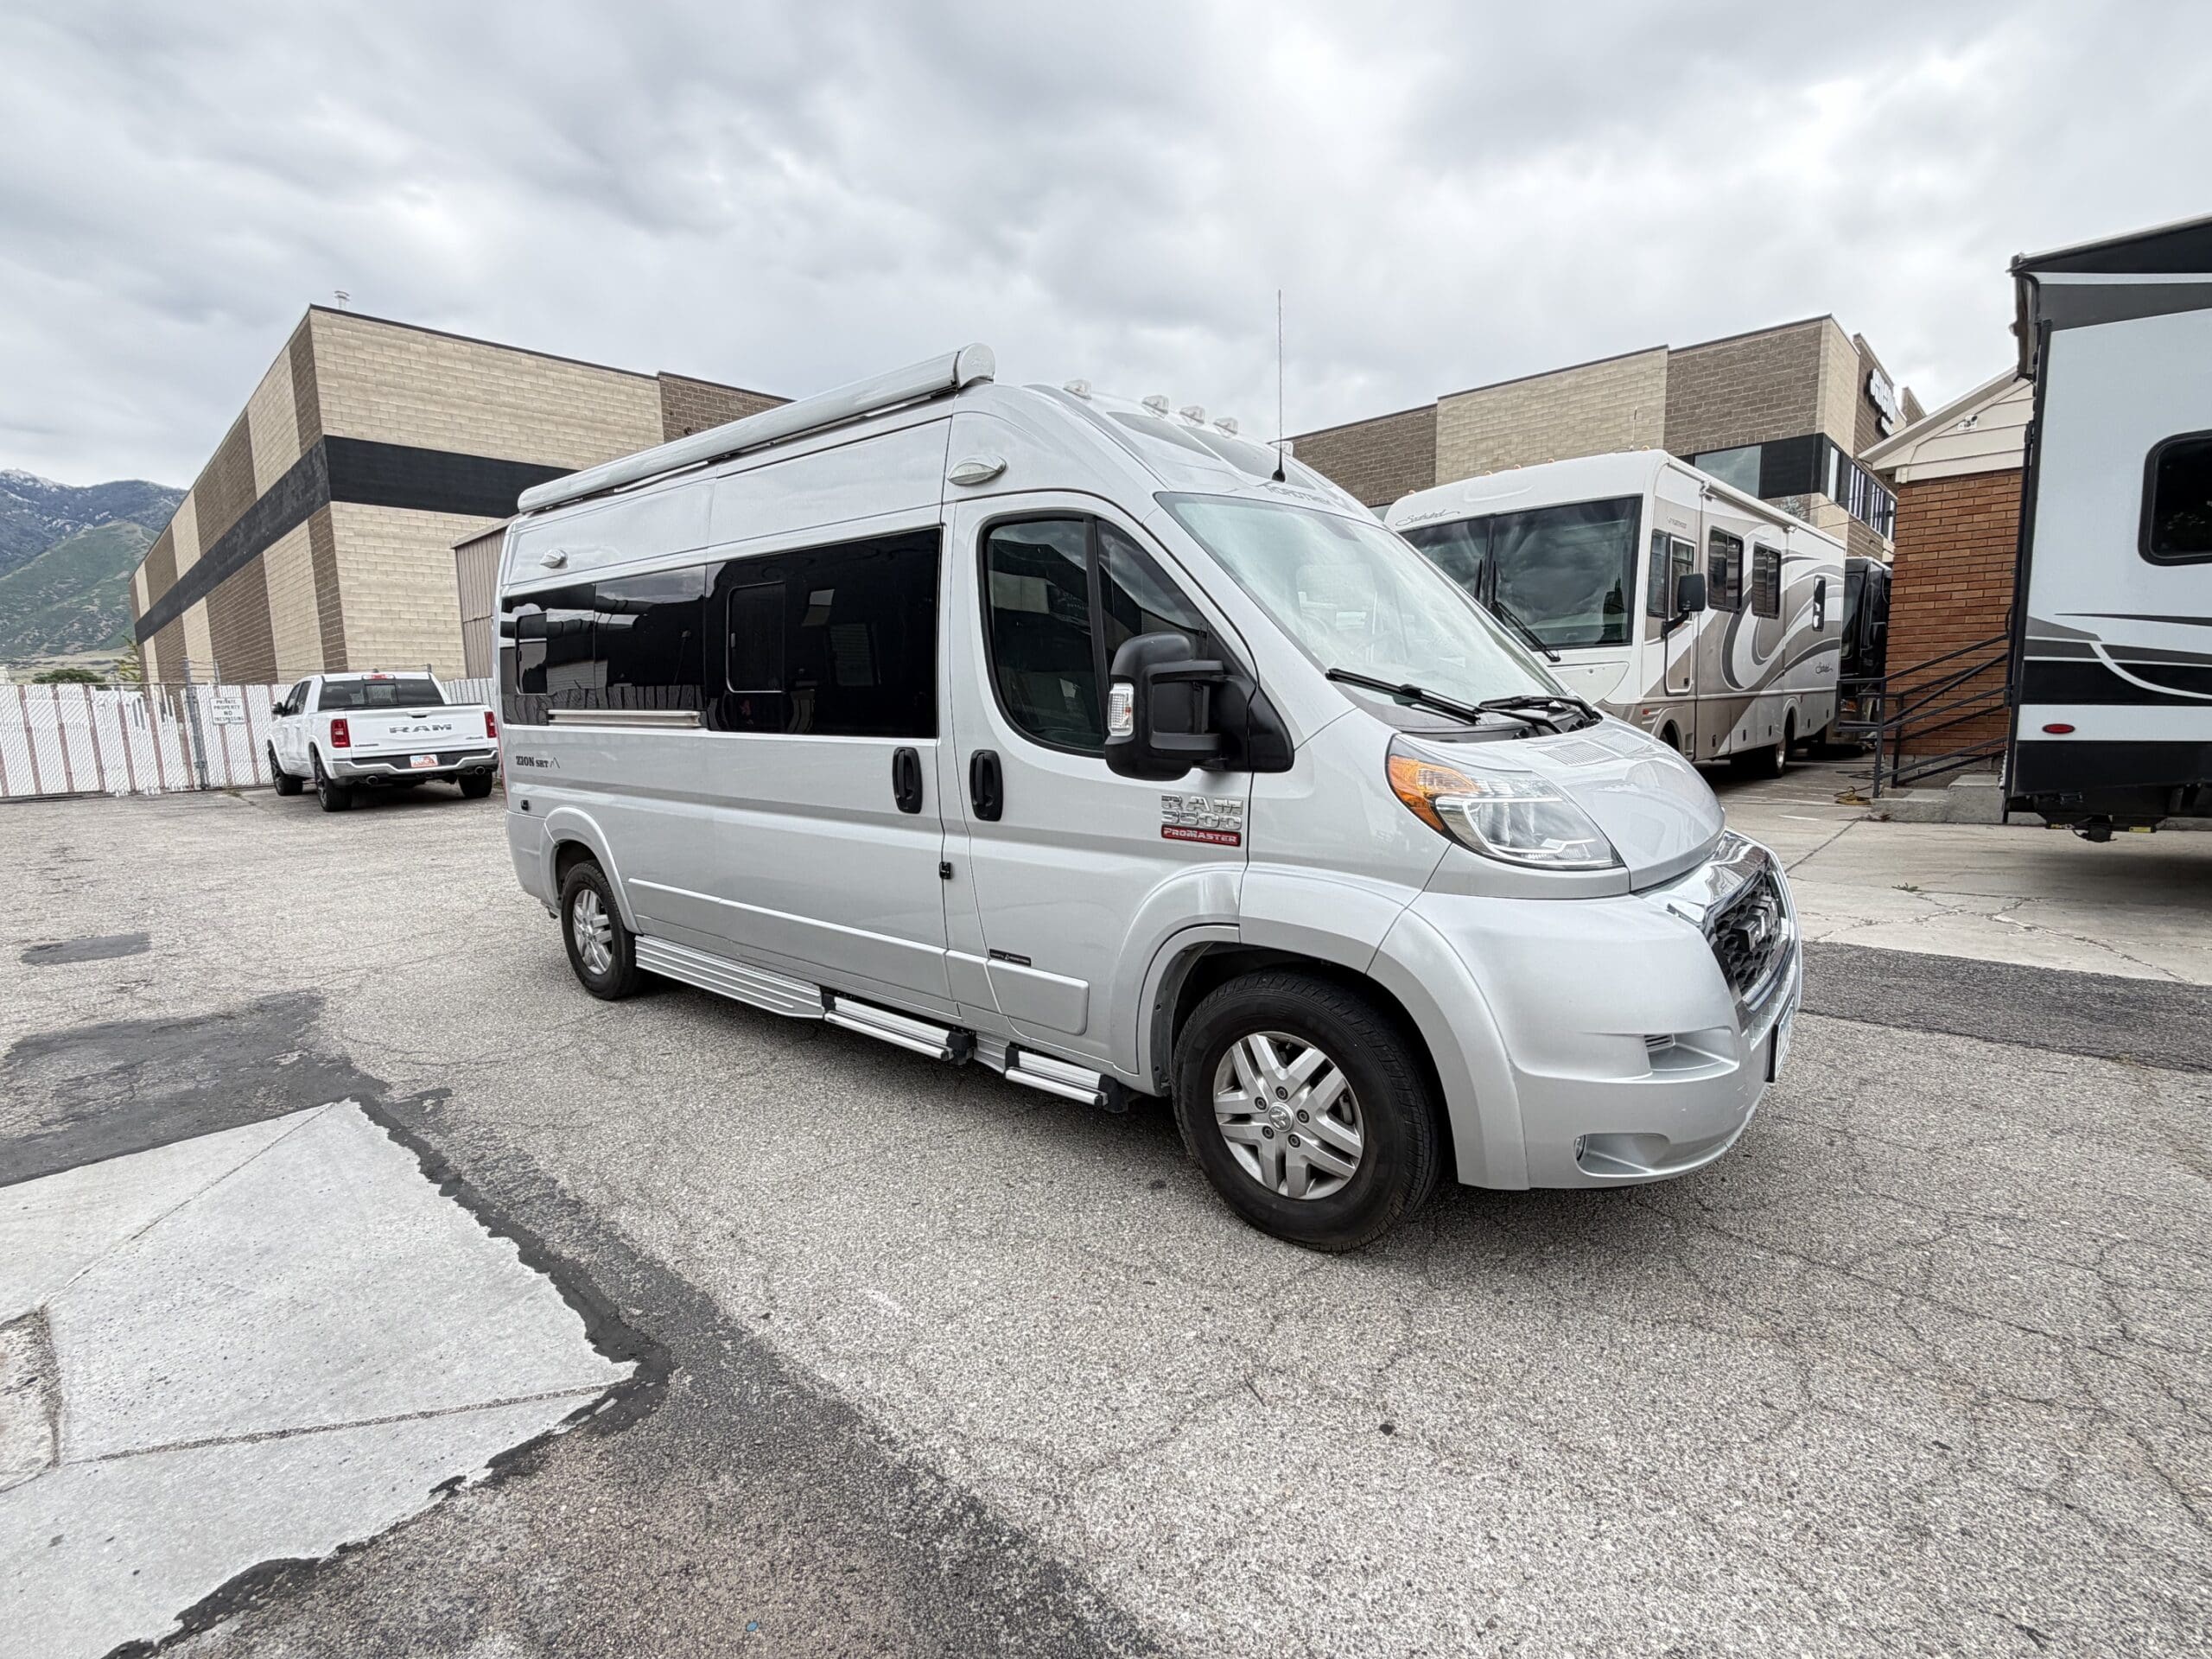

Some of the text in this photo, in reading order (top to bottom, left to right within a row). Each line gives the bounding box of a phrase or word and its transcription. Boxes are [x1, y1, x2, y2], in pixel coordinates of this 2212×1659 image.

[390, 724, 452, 733] RAM
[516, 755, 549, 768] ZION SRT
[1161, 794, 1244, 815] RAM
[1161, 810, 1243, 830] 3500
